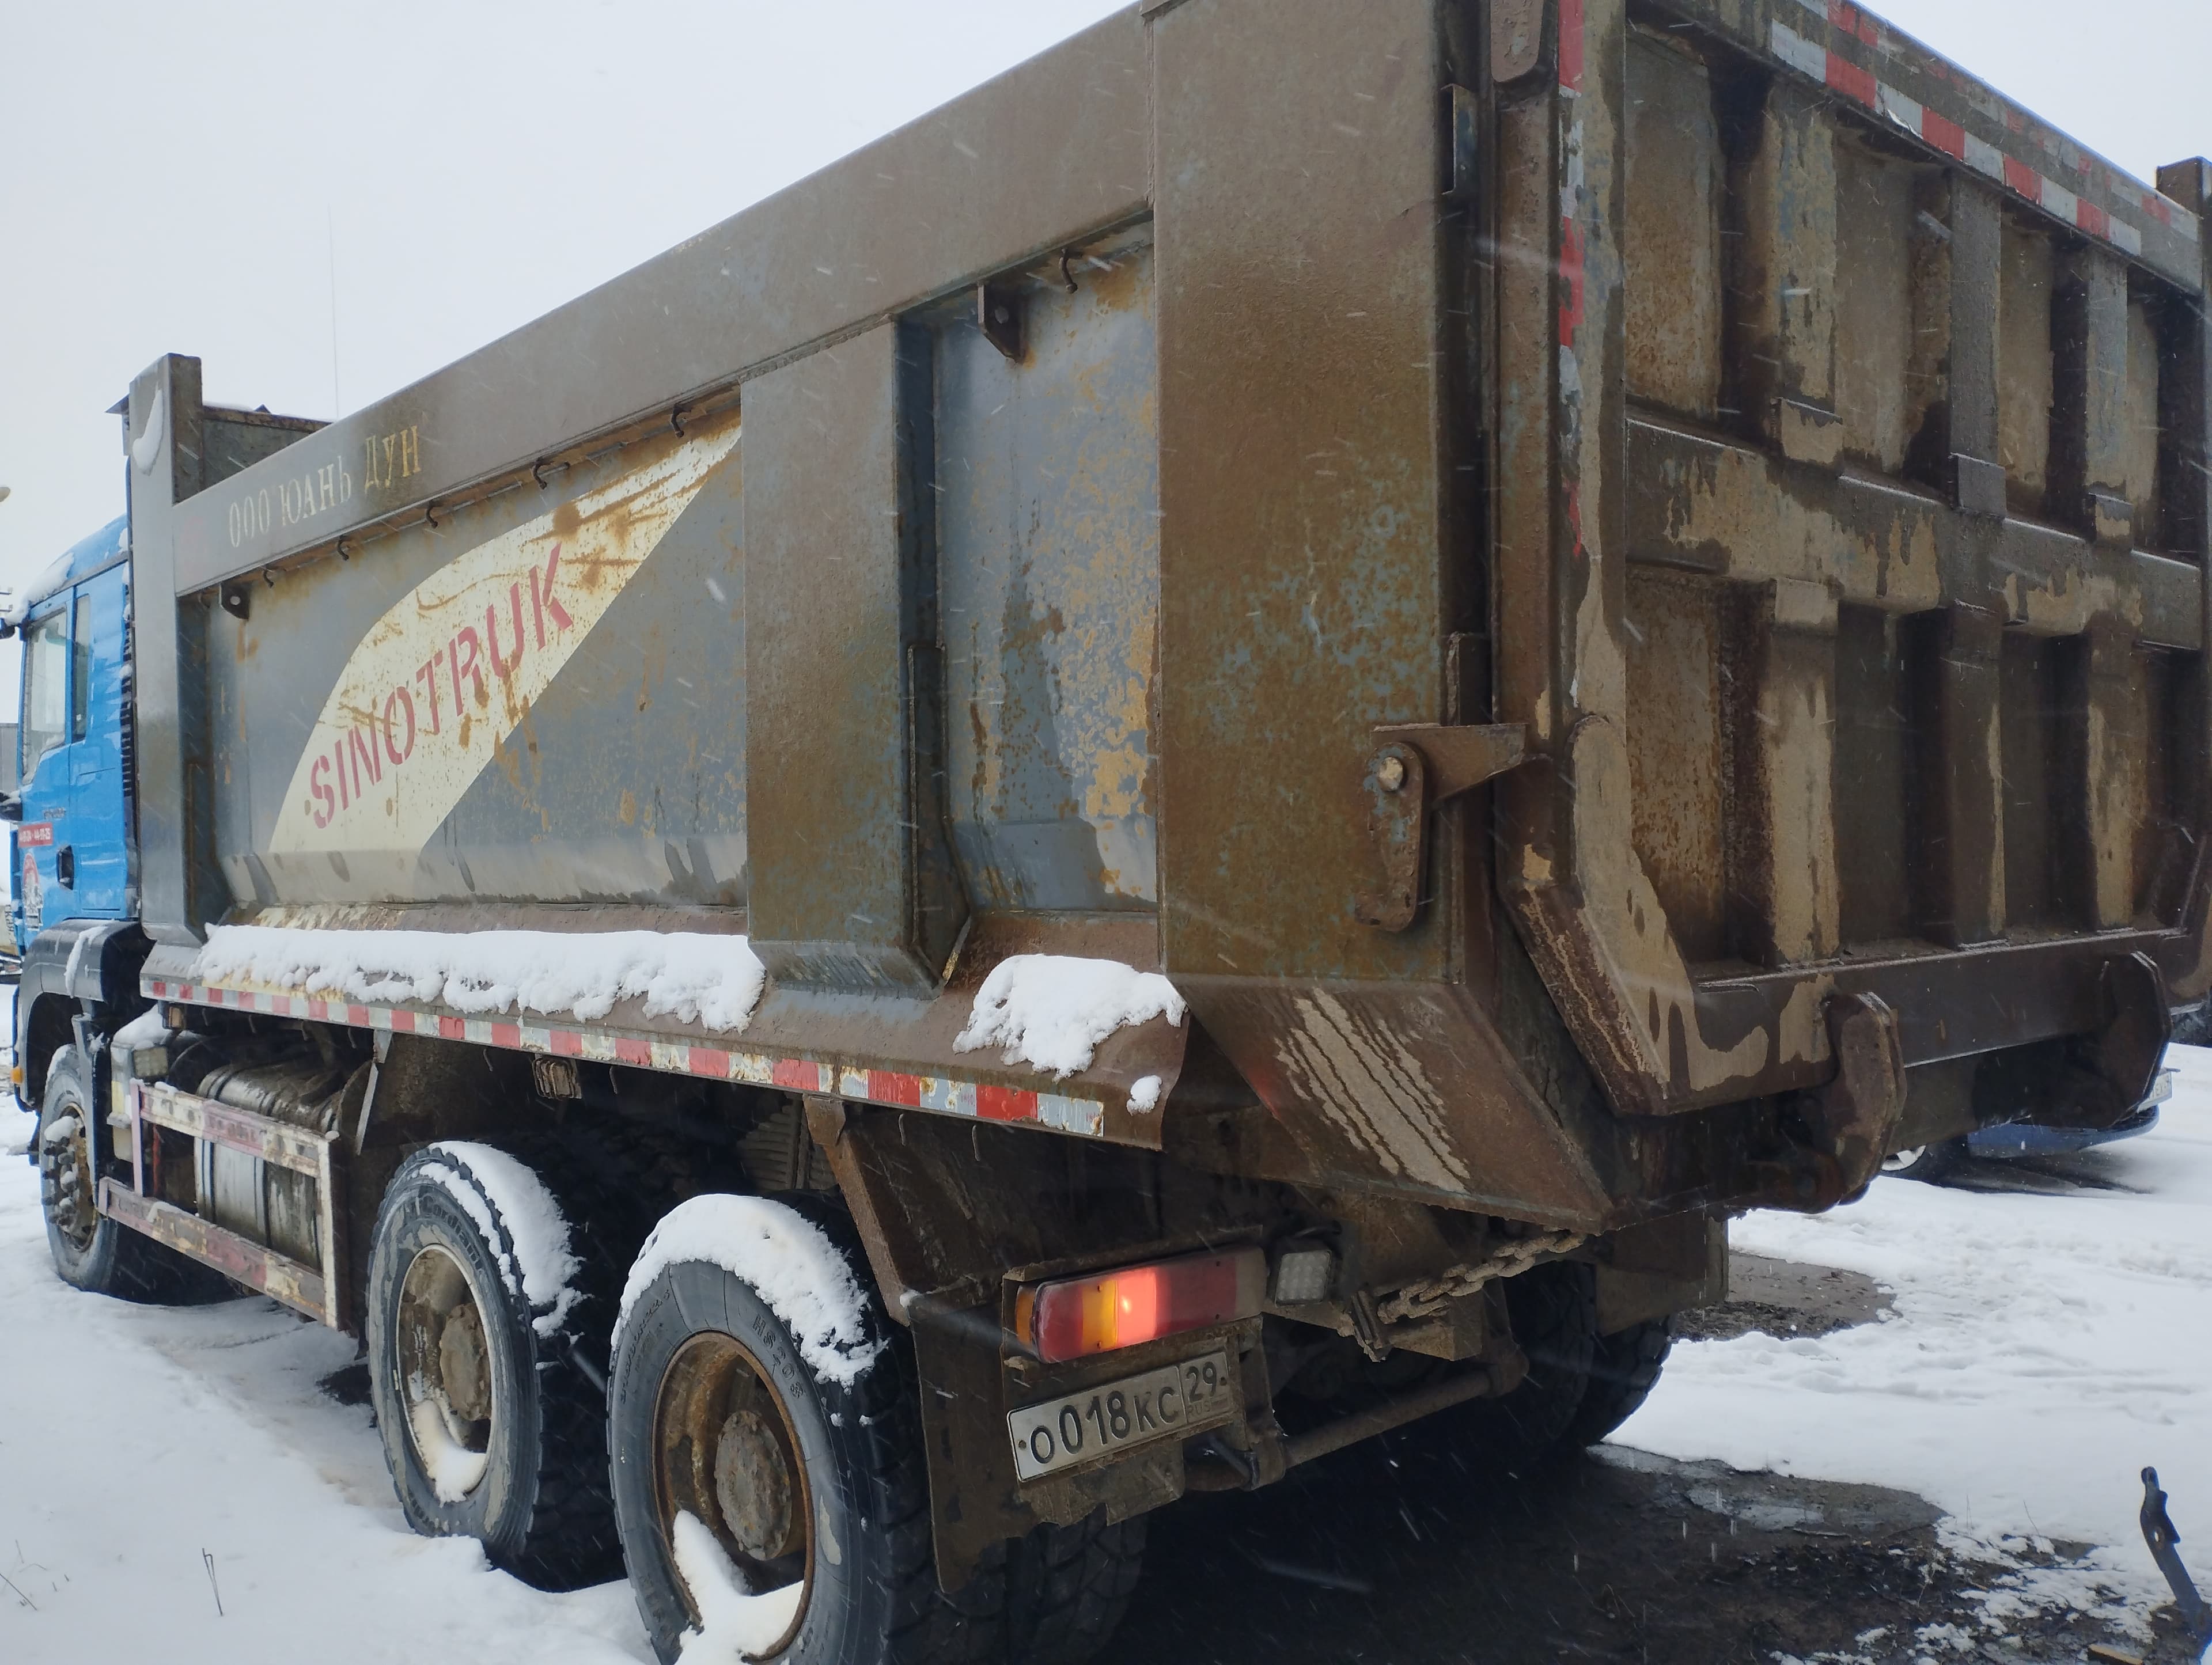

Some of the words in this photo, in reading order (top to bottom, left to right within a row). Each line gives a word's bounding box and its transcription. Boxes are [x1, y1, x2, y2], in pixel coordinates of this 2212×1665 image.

[278, 455, 353, 526] ЮАНЬ
[364, 425, 421, 495] ДУН
[309, 542, 573, 829] SINOTRUK
[1186, 1361, 1217, 1403] 29
